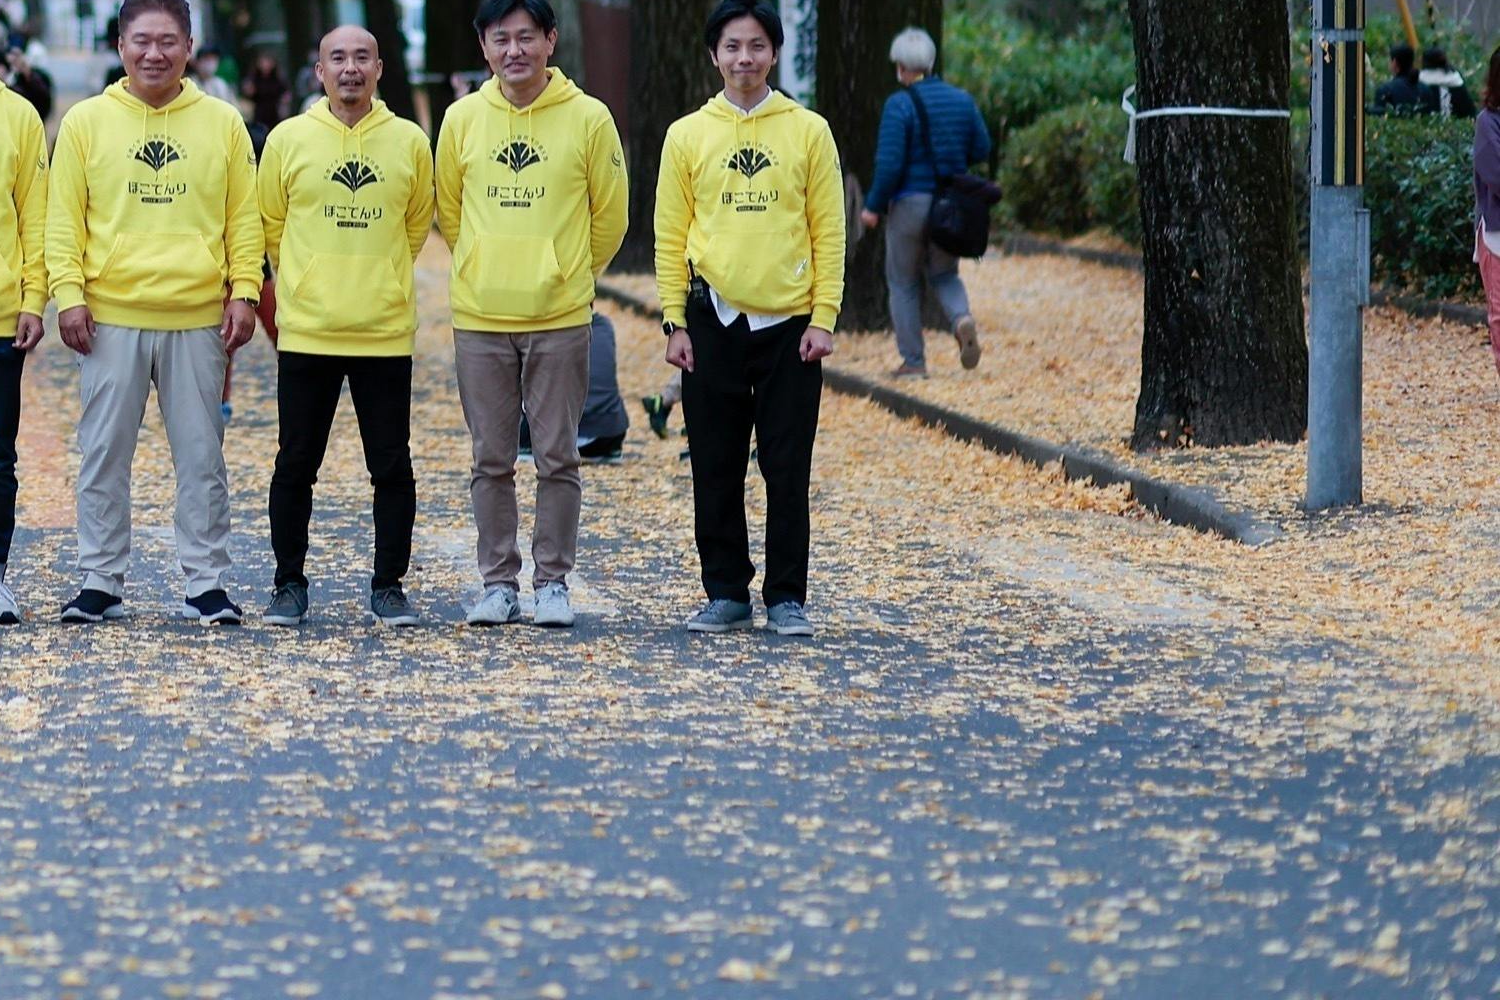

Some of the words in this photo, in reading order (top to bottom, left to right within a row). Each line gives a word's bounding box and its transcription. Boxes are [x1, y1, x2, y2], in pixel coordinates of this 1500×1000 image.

[128, 180, 186, 195] ほこてんり
[487, 186, 545, 199] ほこてんり
[722, 190, 779, 204] ほこてんり
[325, 205, 382, 220] ほこてんり
